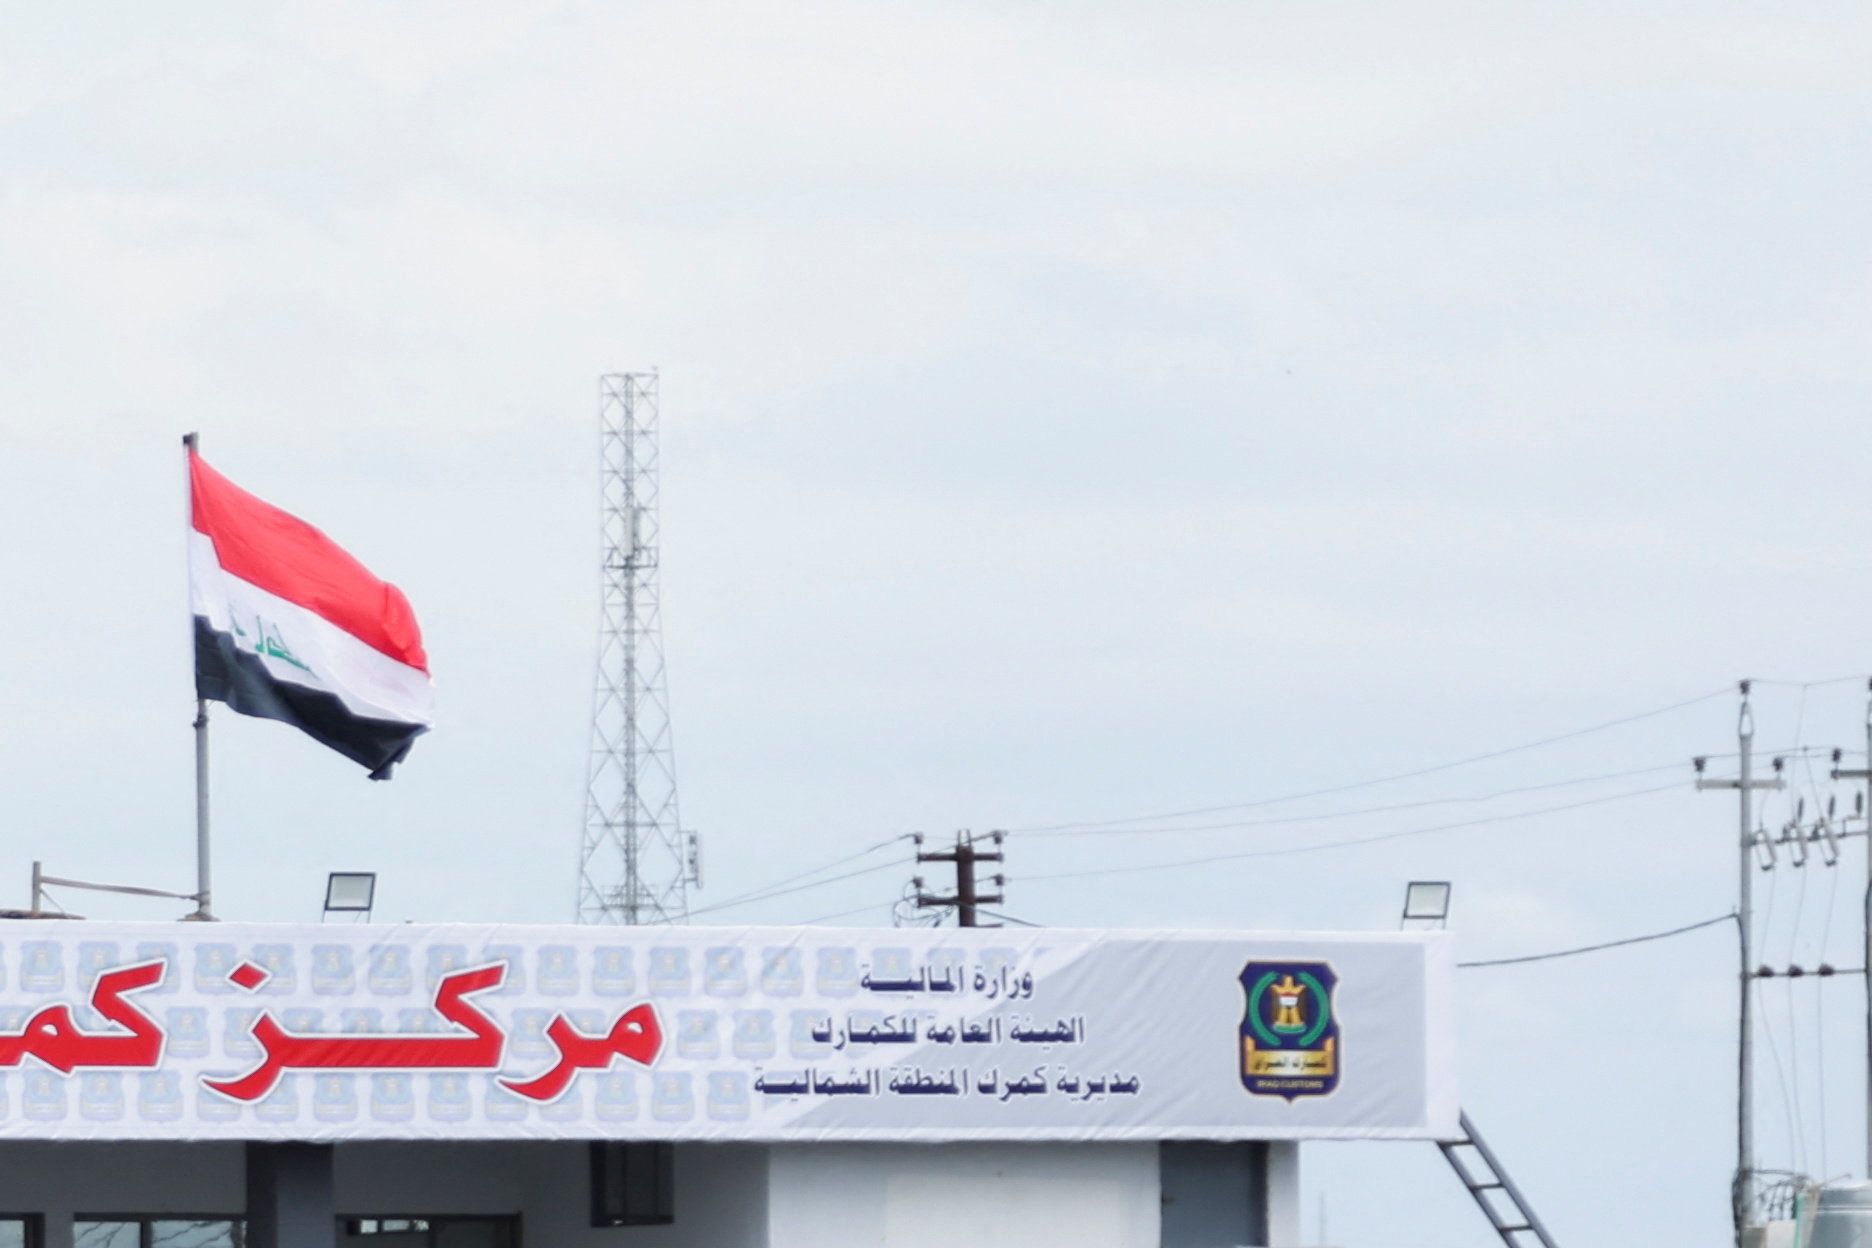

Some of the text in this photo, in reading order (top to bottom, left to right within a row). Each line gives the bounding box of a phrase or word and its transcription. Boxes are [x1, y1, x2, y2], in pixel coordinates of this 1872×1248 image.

[860, 964, 1033, 1000] وزارة المالية
[208, 964, 662, 1102] مركز
[811, 1016, 917, 1051] للكمارك
[926, 1016, 1001, 1045] العامة
[753, 1067, 1140, 1102] مديرية كمرك المنطقة الشمالية
